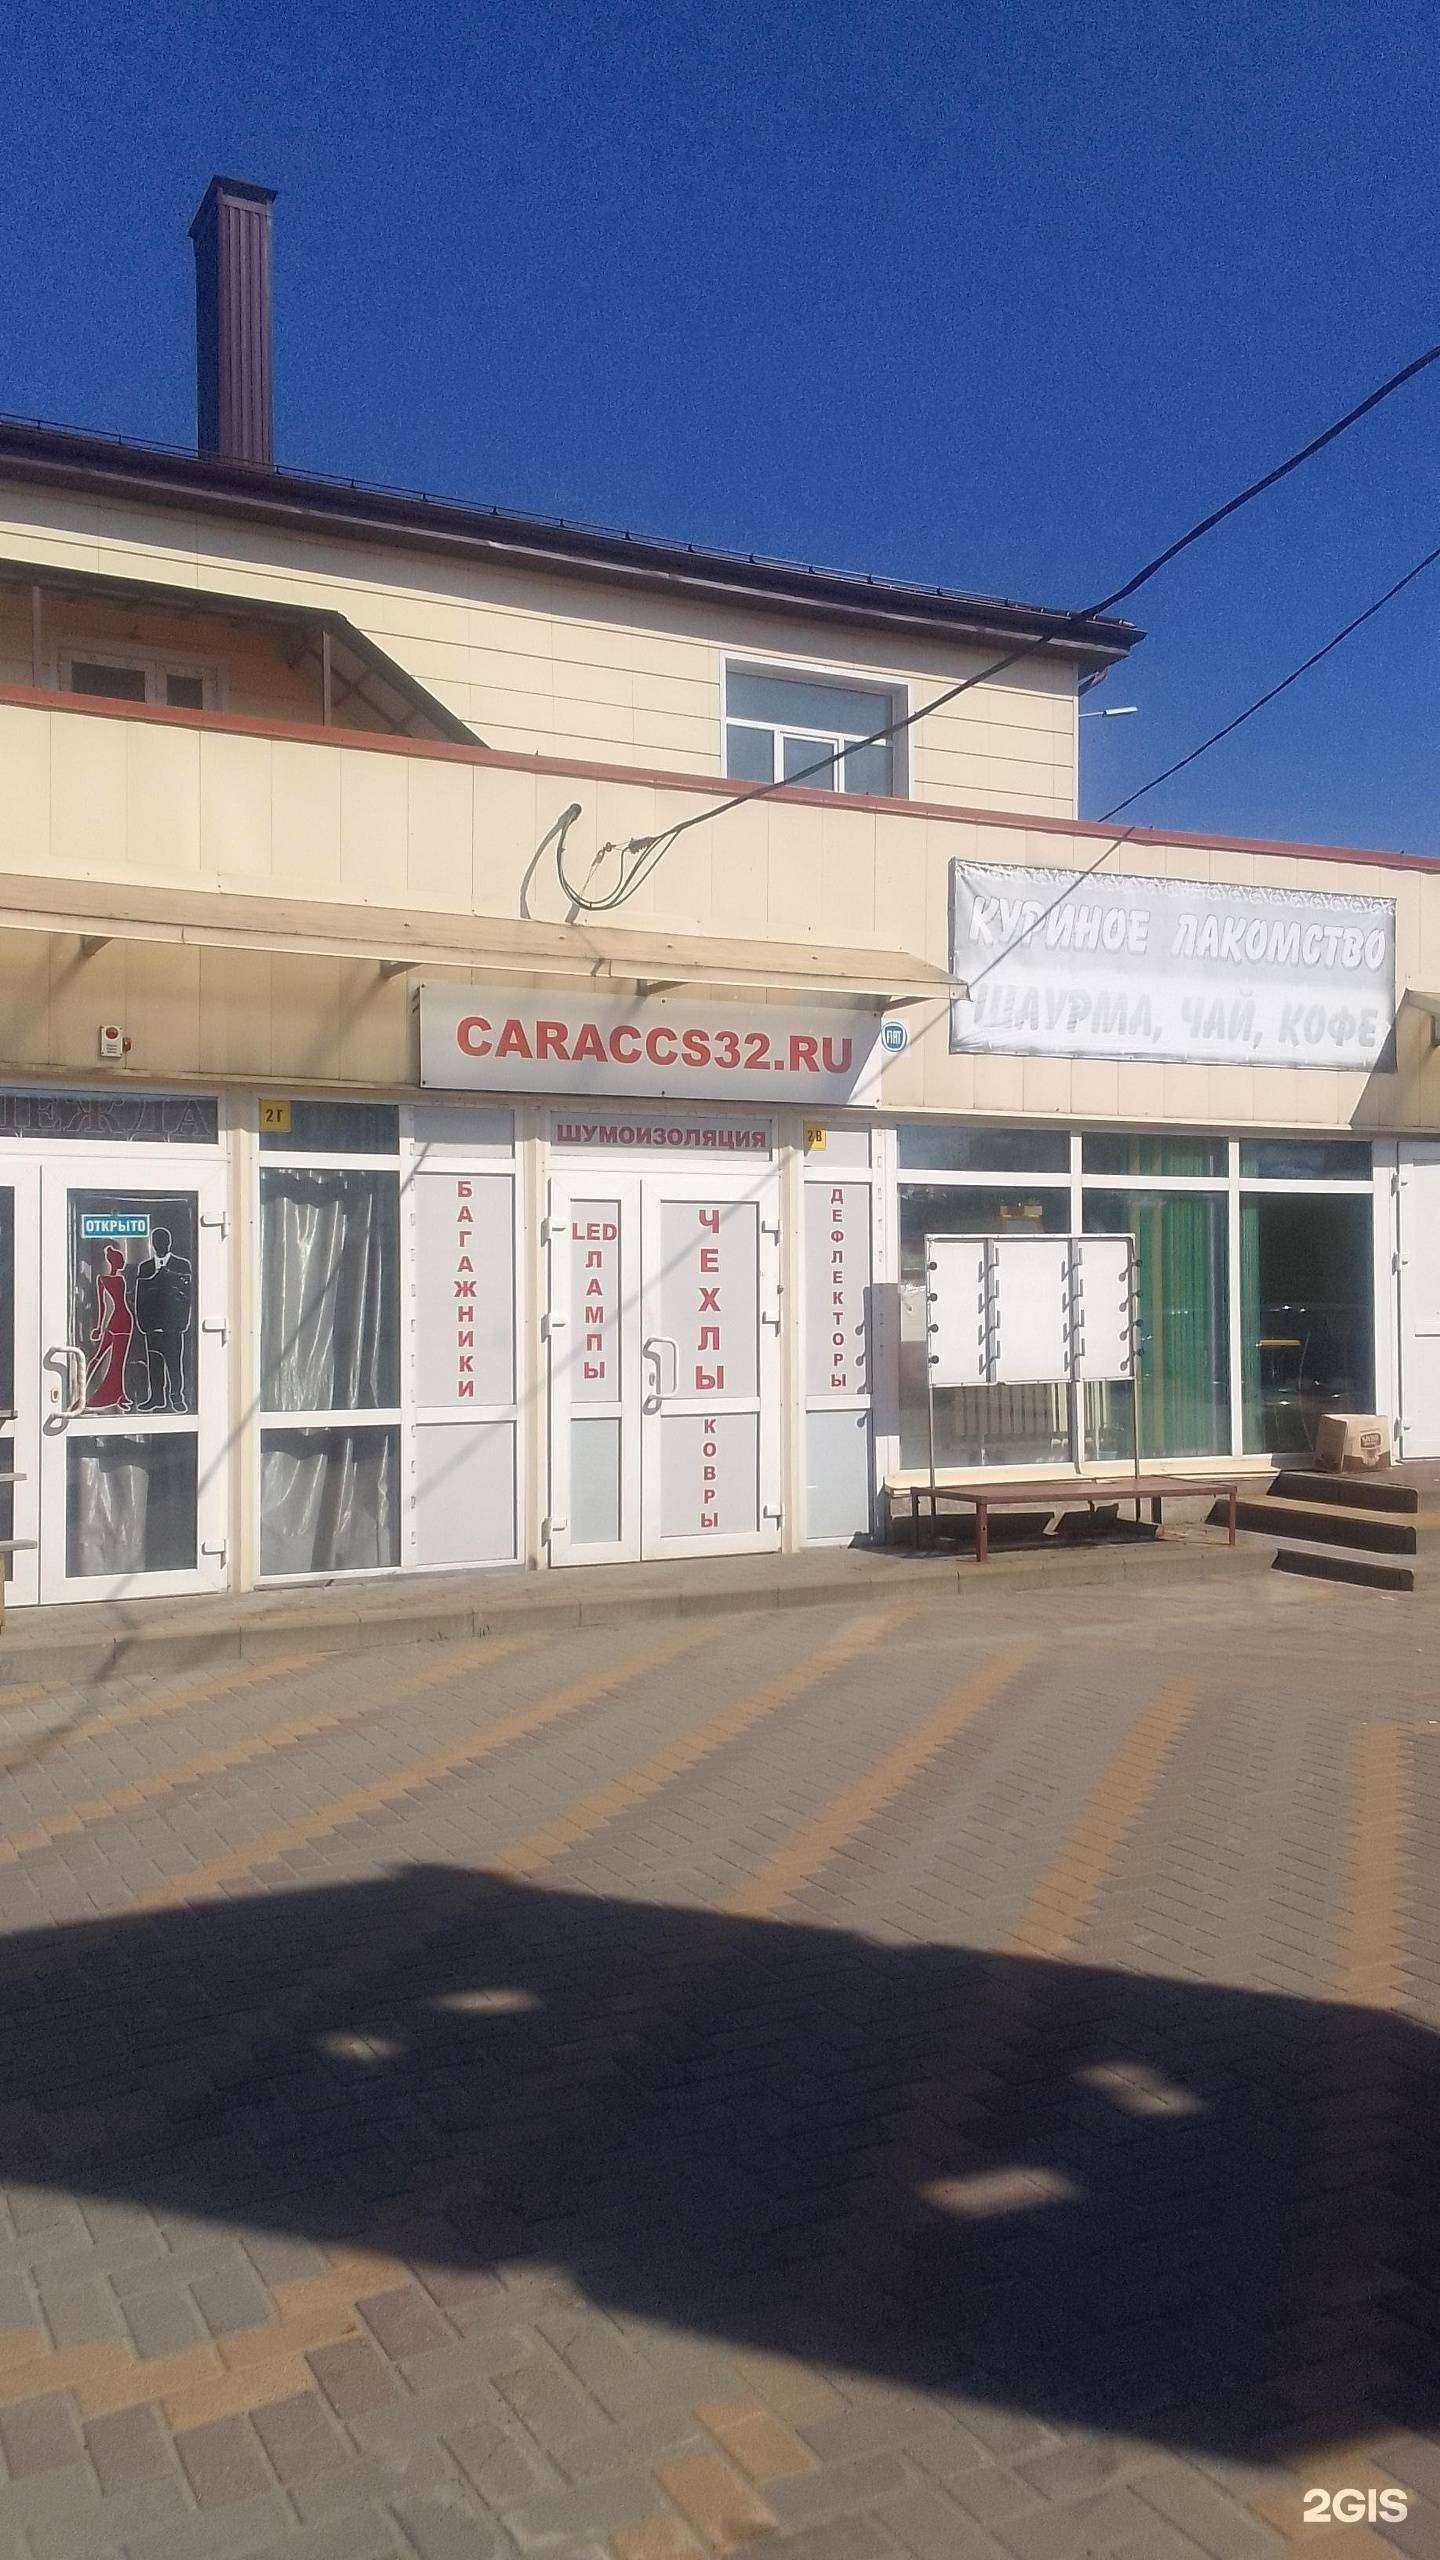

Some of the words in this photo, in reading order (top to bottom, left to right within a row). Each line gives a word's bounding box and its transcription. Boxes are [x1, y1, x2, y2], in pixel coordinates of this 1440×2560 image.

[969, 895, 1151, 954] КУРИНОЕ
[1173, 914, 1387, 970] ЛАКОМСТВО
[456, 1016, 853, 1074] CARACCS32.RU
[1181, 988, 1264, 1049] ЧАЙ,
[1278, 1001, 1378, 1047] КОФЕ
[556, 1124, 767, 1148] ШУМОИЗОЛЯЦИЯ
[85, 1220, 146, 1232] ОТКРЫТО
[571, 1222, 618, 1241] LED
[453, 1180, 477, 1398] БАГАЖНИКИ
[583, 1250, 606, 1379] ЛАМПЫ
[695, 1209, 725, 1390] ЧЕХЛЫ
[830, 1188, 847, 1387] ДЕФЛЕКТОРЫ
[700, 1418, 719, 1528] КОВРЫ
